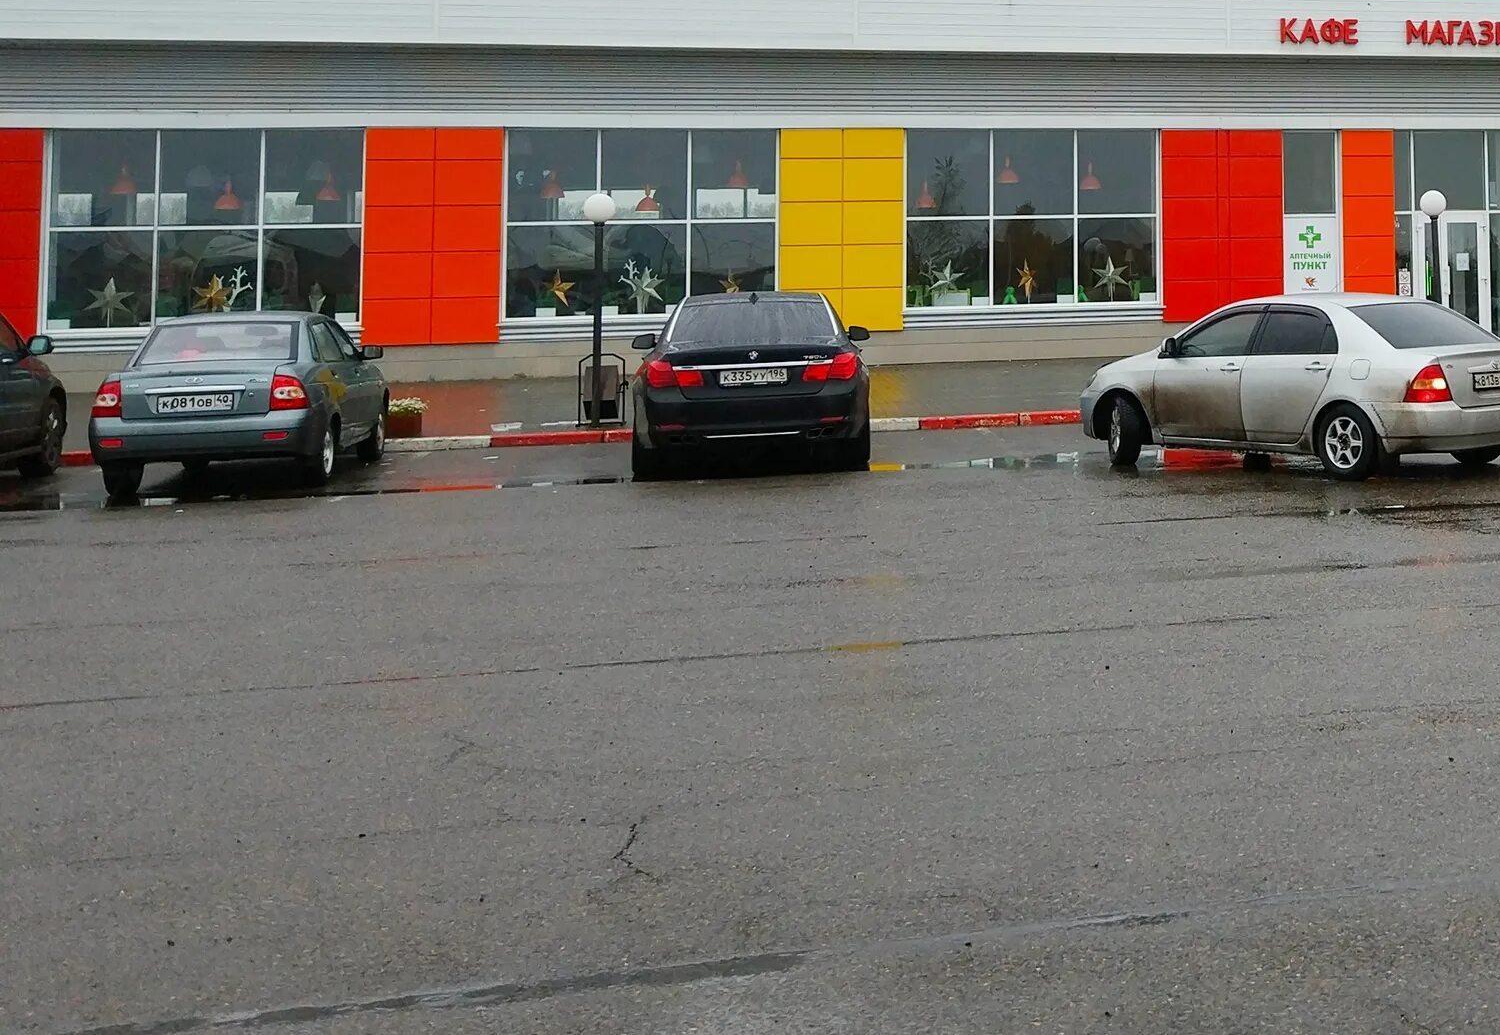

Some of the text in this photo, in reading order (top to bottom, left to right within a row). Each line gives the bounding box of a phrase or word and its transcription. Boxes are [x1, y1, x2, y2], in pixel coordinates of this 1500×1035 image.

[1280, 18, 1359, 45] КАФЕ
[1289, 252, 1332, 260] АПТЕЧНЫЙ
[1293, 261, 1328, 270] ПУНКТ
